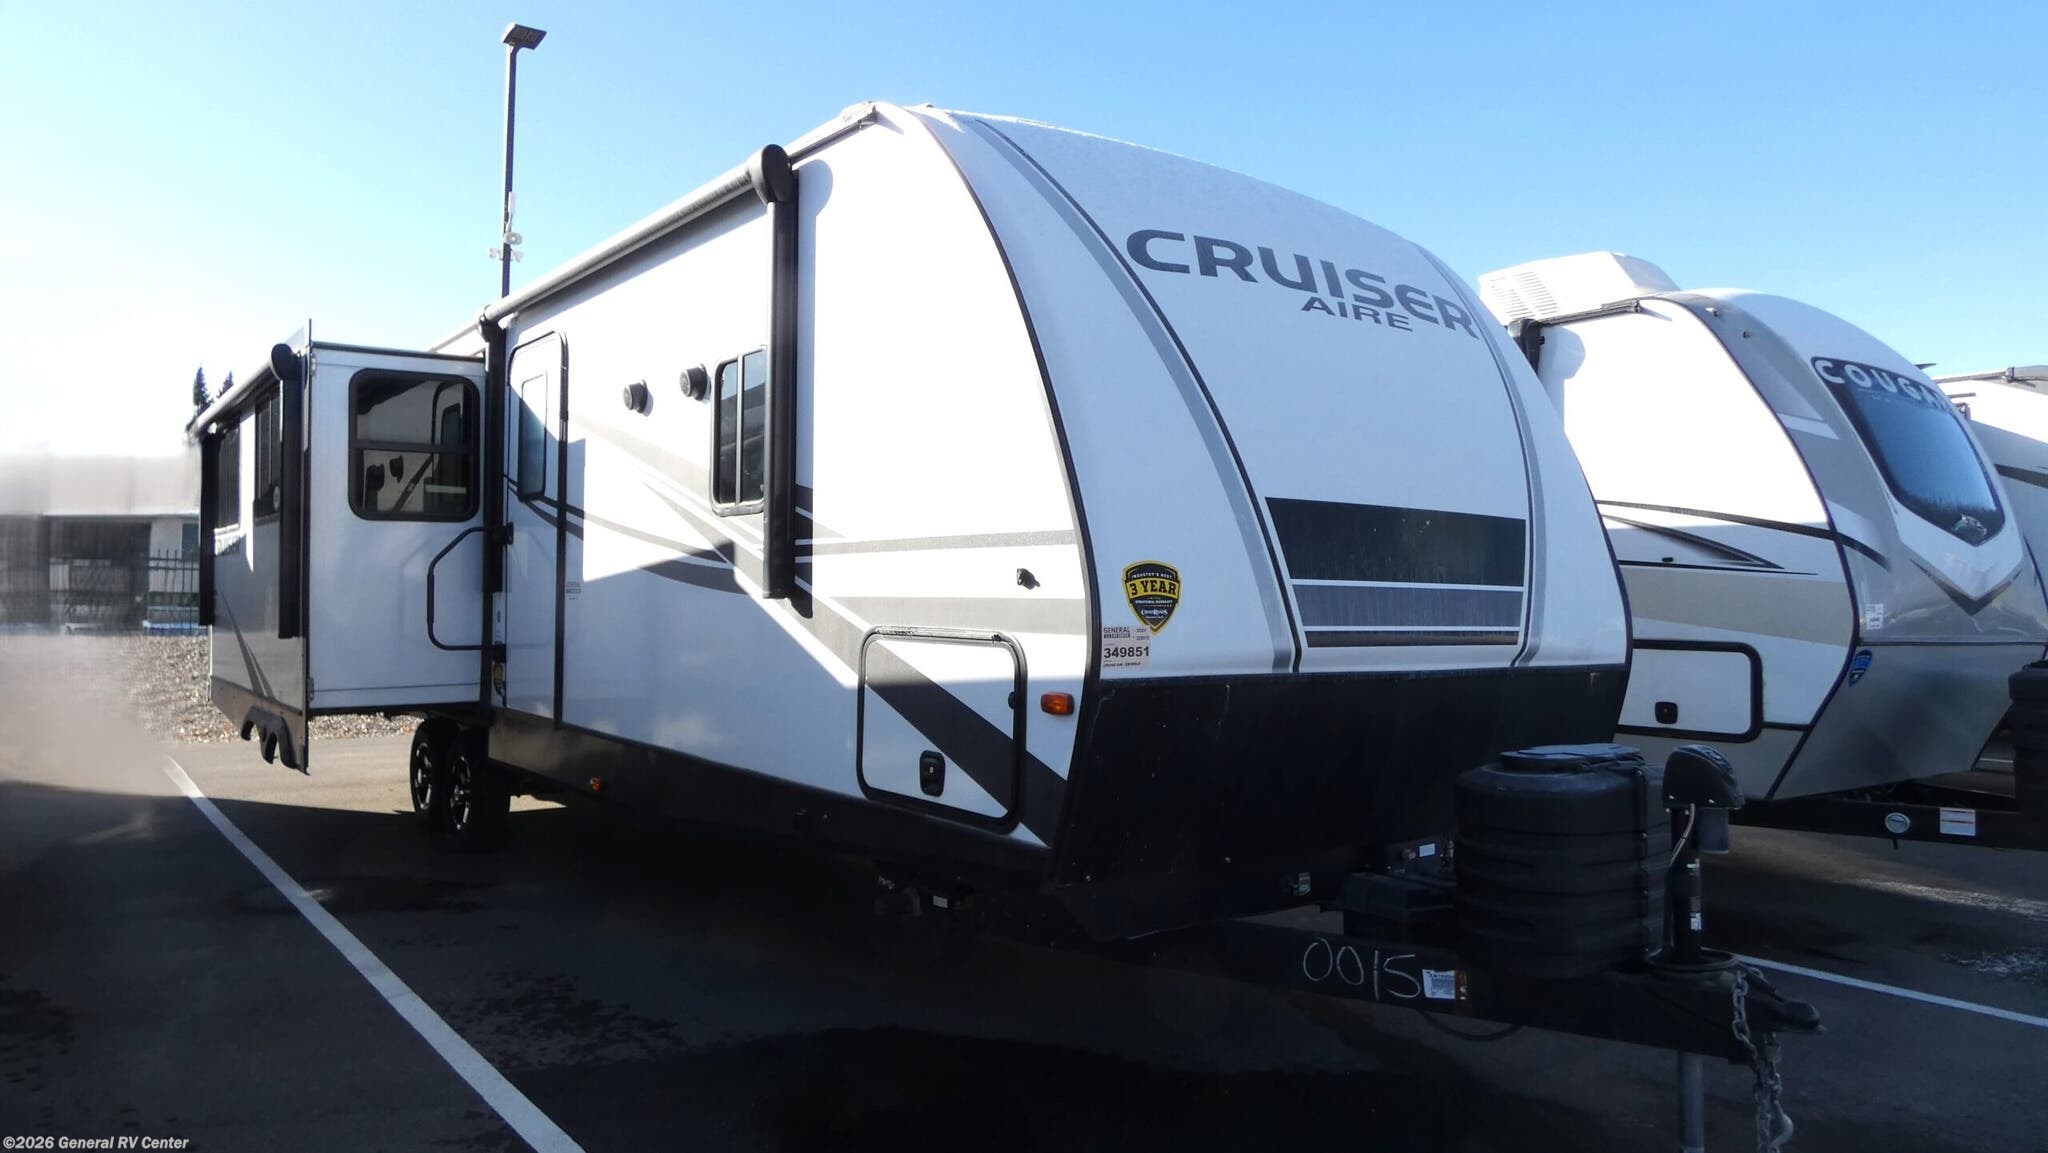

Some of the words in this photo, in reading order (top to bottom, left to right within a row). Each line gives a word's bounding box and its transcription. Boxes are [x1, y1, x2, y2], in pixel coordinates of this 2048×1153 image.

[1126, 229, 1479, 340] CRUISER
[1301, 297, 1413, 332] AIRE
[1129, 583, 1138, 596] 3
[1140, 580, 1177, 595] YEAR
[1103, 626, 1130, 634] GENERAL
[1103, 646, 1150, 658] 349851
[1303, 938, 1421, 1000] 0015
